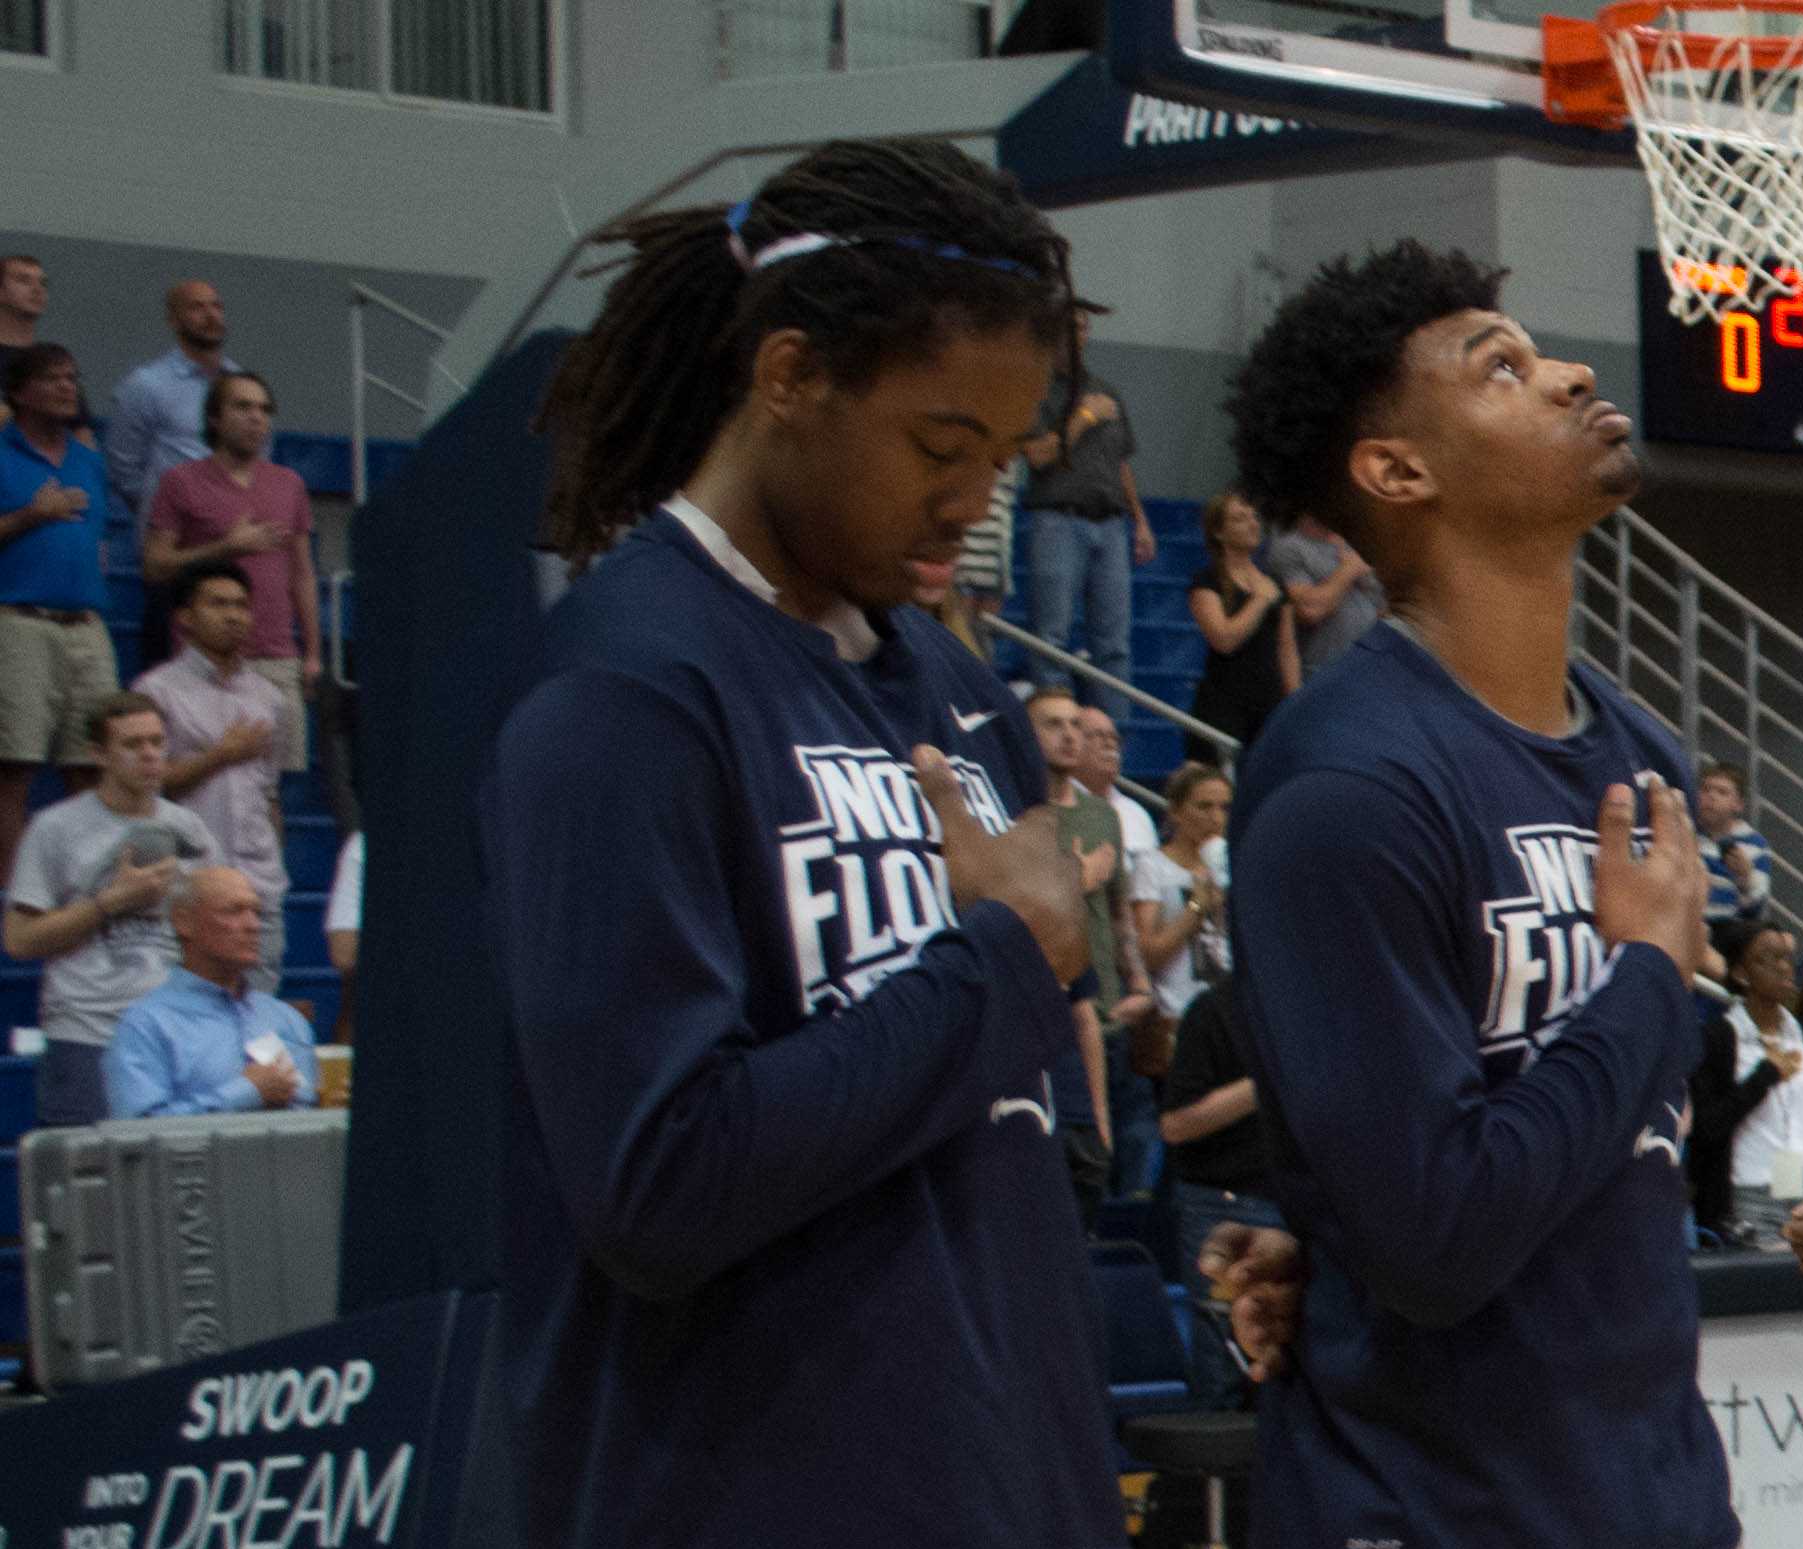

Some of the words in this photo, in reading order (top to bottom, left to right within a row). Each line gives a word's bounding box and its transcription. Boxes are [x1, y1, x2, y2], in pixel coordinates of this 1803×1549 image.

[1722, 312, 1761, 393] 0
[181, 1358, 375, 1440] SWOOP
[84, 1472, 149, 1508] INTO
